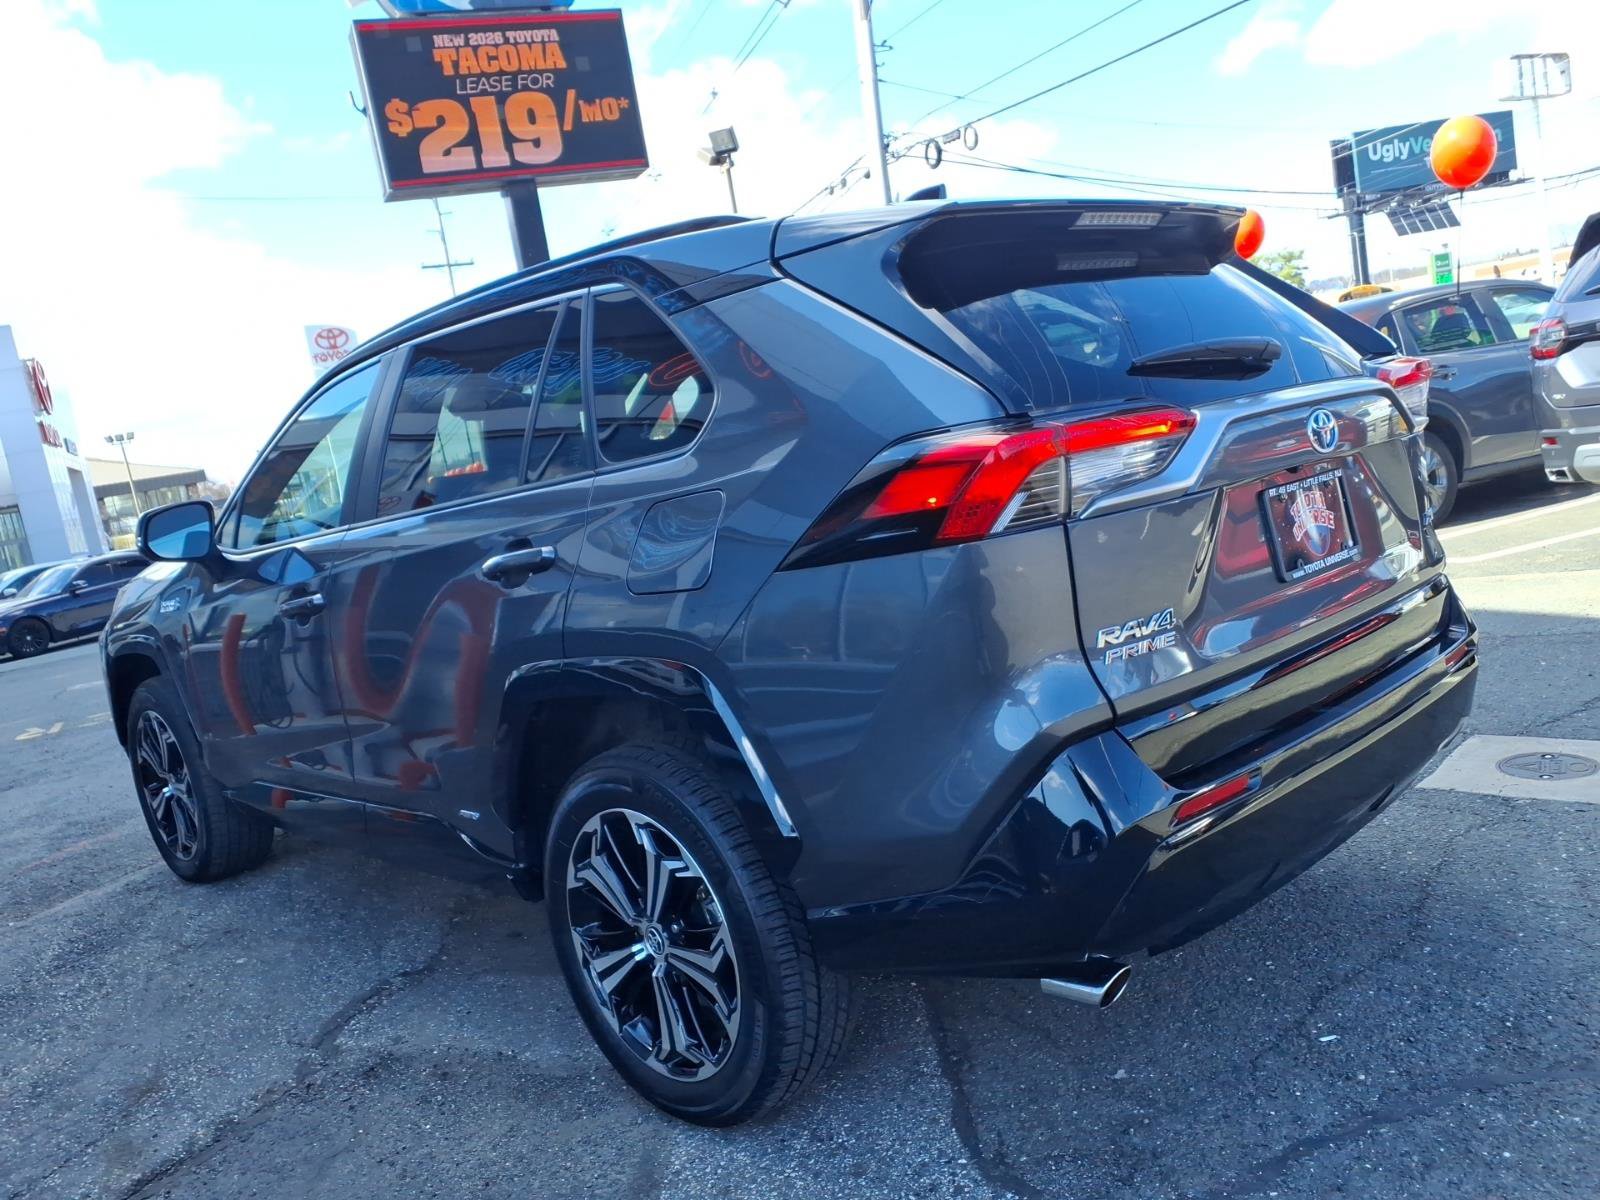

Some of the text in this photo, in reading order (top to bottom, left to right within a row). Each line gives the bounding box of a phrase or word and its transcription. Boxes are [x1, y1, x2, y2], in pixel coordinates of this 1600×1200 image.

[432, 29, 560, 48] NEW 2026 TOYOTA
[432, 42, 567, 76] TACOMA
[456, 72, 554, 95] LEASE FOR
[312, 349, 350, 364] TOYO
[1303, 477, 1319, 488] LITTLE
[1096, 607, 1177, 649] RAV4
[1104, 631, 1176, 666] PRIME
